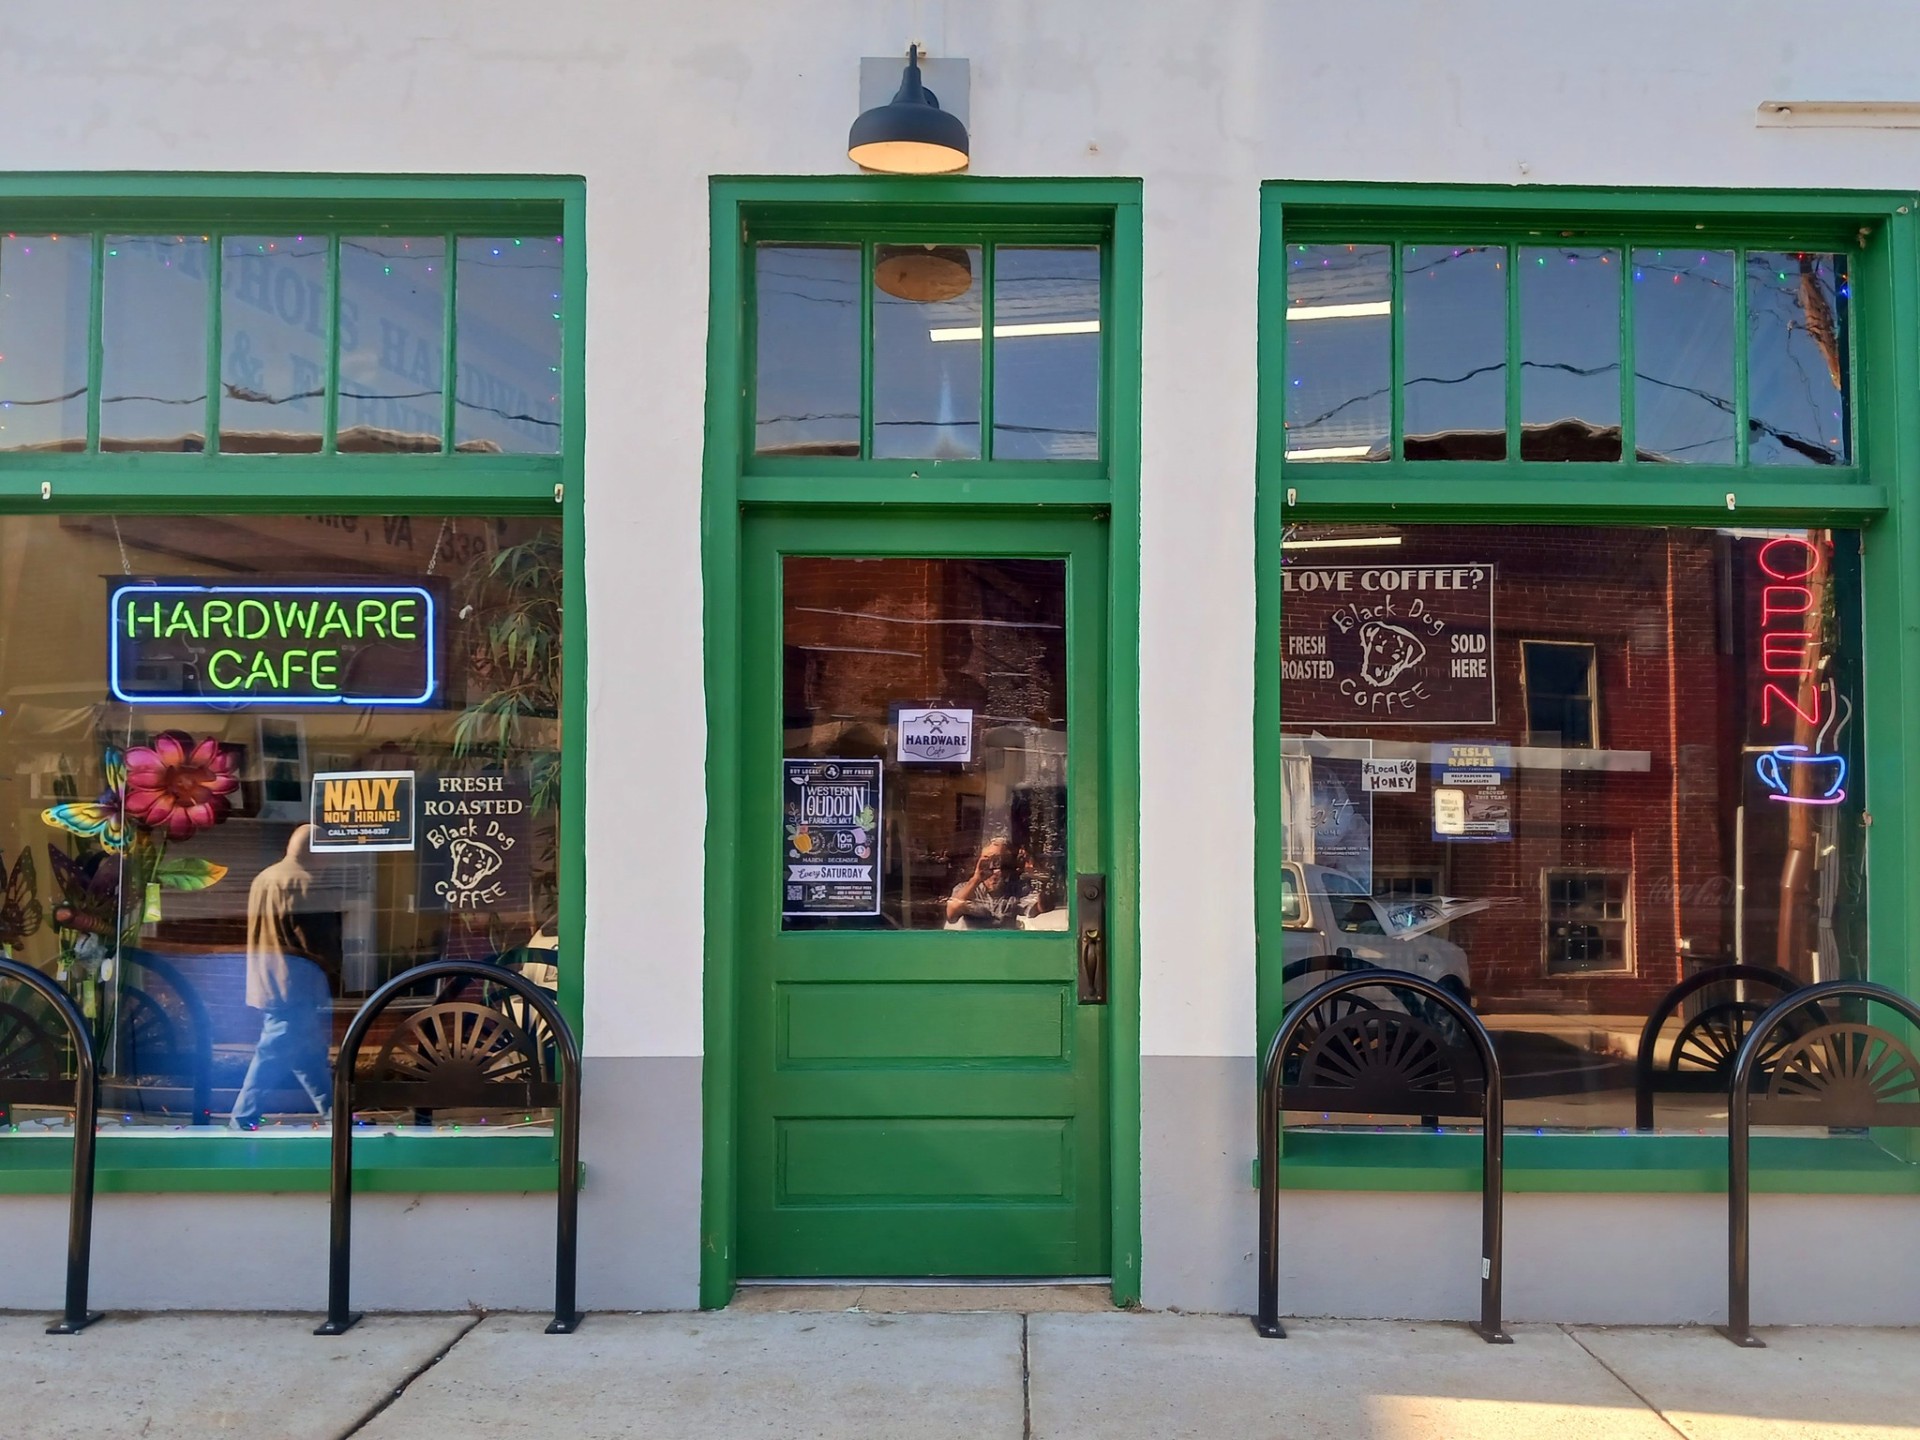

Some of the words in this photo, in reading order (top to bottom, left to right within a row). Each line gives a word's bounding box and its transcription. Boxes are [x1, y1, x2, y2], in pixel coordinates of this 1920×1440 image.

[1283, 570, 1353, 592] LOVE
[1361, 569, 1484, 591] COFFEE?
[127, 598, 417, 640] HARDWARE
[1331, 594, 1397, 634] Black
[1408, 598, 1446, 636] Dog
[1758, 537, 1820, 726] OPEN
[1289, 636, 1326, 655] FRESH
[1451, 634, 1486, 654] SOLD
[208, 650, 338, 691] CAFE
[1282, 660, 1335, 680] ROASTED
[1451, 658, 1487, 679] HERE
[1339, 678, 1431, 715] COFFEE
[906, 735, 967, 746] HARDWARE
[1448, 757, 1495, 767] RAFFLE
[1451, 747, 1490, 757] TESLA
[1372, 765, 1398, 775] Local
[438, 777, 503, 792] FRESH
[807, 786, 852, 796] WESTERN
[323, 779, 400, 811] NAVY
[324, 811, 350, 823] NOW
[355, 811, 400, 823] HIRING!
[424, 799, 523, 816] ROASTED
[426, 818, 478, 850] Black
[486, 820, 516, 850] Dog
[797, 868, 821, 879] Every
[821, 867, 864, 879] SATURDAY
[435, 880, 507, 910] COFFEE
